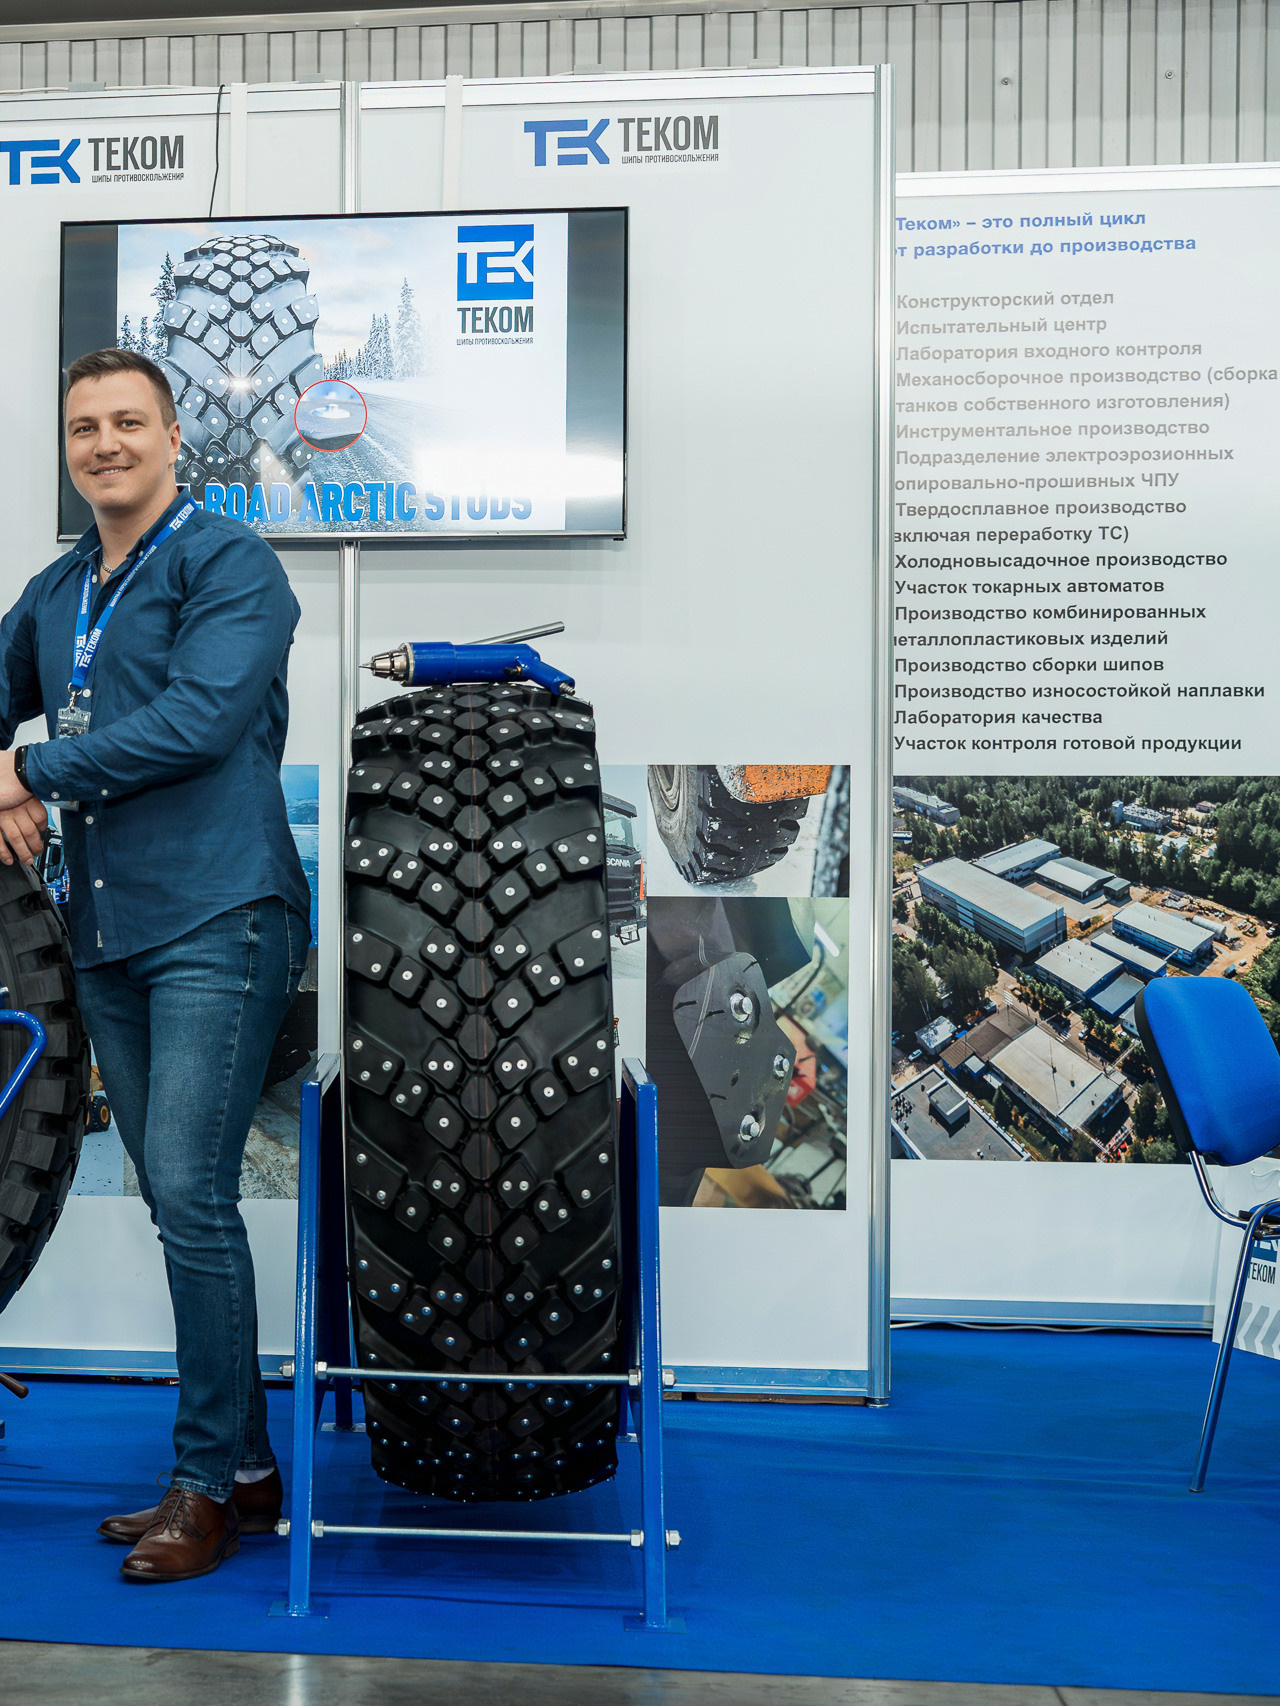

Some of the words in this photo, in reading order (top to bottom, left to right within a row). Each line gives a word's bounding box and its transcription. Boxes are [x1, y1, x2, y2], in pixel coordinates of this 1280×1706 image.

[617, 115, 719, 152] ТЕКОМ
[87, 135, 184, 171] ТЕКОМ
[621, 155, 643, 164] ШИПЫ
[645, 153, 719, 163] ПРОТИВОСКОЛЬЖЕНИЯ
[91, 174, 112, 183] ШИПЫ
[113, 172, 184, 183] ПРОТИВОСКОЛЬЖЕНИЯ
[982, 218, 1013, 228] это
[1020, 212, 1092, 227] полный
[1100, 214, 1145, 227] цикл
[914, 241, 1023, 259] разработки
[1030, 243, 1053, 255] до
[1061, 239, 1195, 255] производства
[898, 291, 1054, 311] Конструкторский
[1061, 294, 1113, 307] отдел
[457, 306, 534, 334] ТЕКОМ
[897, 318, 1047, 334] Испытательный
[1054, 320, 1106, 334] центр
[457, 338, 475, 346] ШИПЫ
[475, 337, 534, 346] ПРОТИВОСКОЛЬЖЕНИЯ
[896, 346, 1017, 363] Лаборатория
[1024, 346, 1110, 359] входного
[1117, 344, 1201, 359] контроля
[897, 371, 1063, 388] Механосборочное
[1070, 371, 1201, 386] производство
[1208, 366, 1277, 384] (сборка
[896, 401, 957, 412] танков
[964, 397, 1090, 411] собственного
[1097, 393, 1229, 411] изготовления)
[897, 425, 1072, 441] Инструментальное
[1079, 423, 1209, 438] производство
[897, 451, 1040, 467] Подразделение
[1046, 449, 1234, 465] электроэрозионных
[1142, 473, 1179, 486] ЧПУ
[298, 481, 417, 522] ARCTIC
[896, 503, 1049, 519] Твердосплавное
[1056, 503, 1186, 517] производство
[977, 527, 1092, 544] переработку
[1098, 526, 1128, 543] ТС)
[895, 555, 1089, 570] Холодновысадочное
[1097, 555, 1227, 569] производство
[895, 581, 967, 594] Участок
[972, 583, 1061, 596] токарных
[1067, 582, 1164, 592] автоматов
[896, 607, 1026, 623] Производство
[1033, 605, 1206, 622] комбинированных
[1091, 631, 1167, 647] изделий
[895, 659, 1026, 675] Производство
[1033, 657, 1096, 674] сборки
[1104, 661, 1164, 671] шипов
[895, 684, 1026, 701] Производство
[1033, 683, 1170, 697] износостойкой
[1178, 687, 1264, 697] наплавки
[894, 710, 1015, 727] Лаборатория
[1022, 713, 1102, 723] качества
[894, 736, 966, 750] Участок
[972, 740, 1056, 753] контроля
[1064, 736, 1135, 749] готовой
[1142, 739, 1241, 753] продукции
[606, 857, 631, 868] SCANIA
